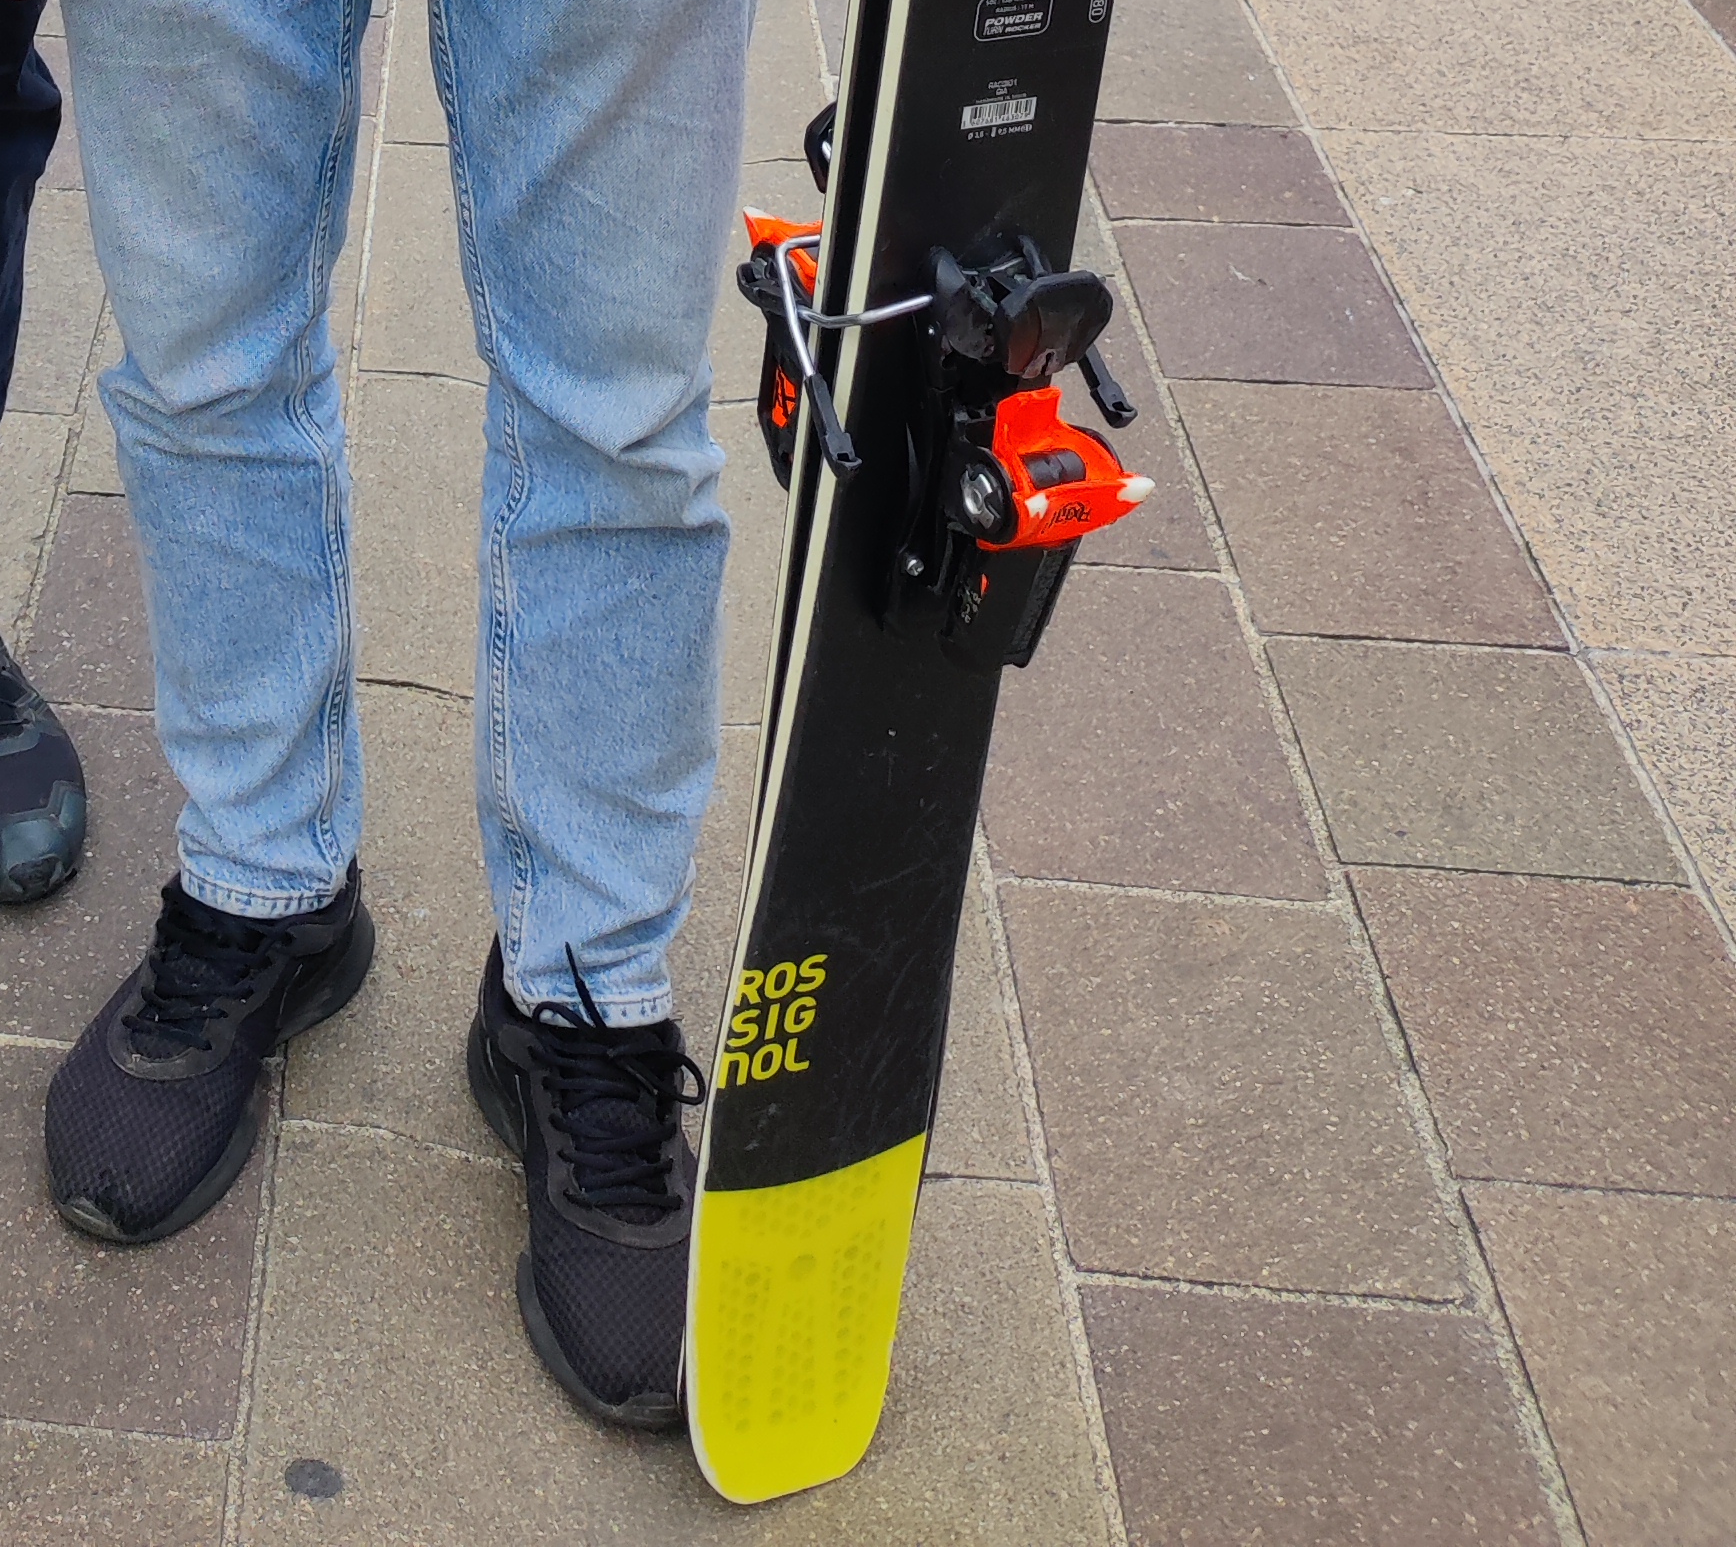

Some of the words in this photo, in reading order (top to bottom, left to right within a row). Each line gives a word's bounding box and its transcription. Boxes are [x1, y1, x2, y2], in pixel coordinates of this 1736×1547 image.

[984, 11, 1044, 27] POWDER
[733, 953, 829, 1007] ROS
[726, 996, 817, 1048] SIG
